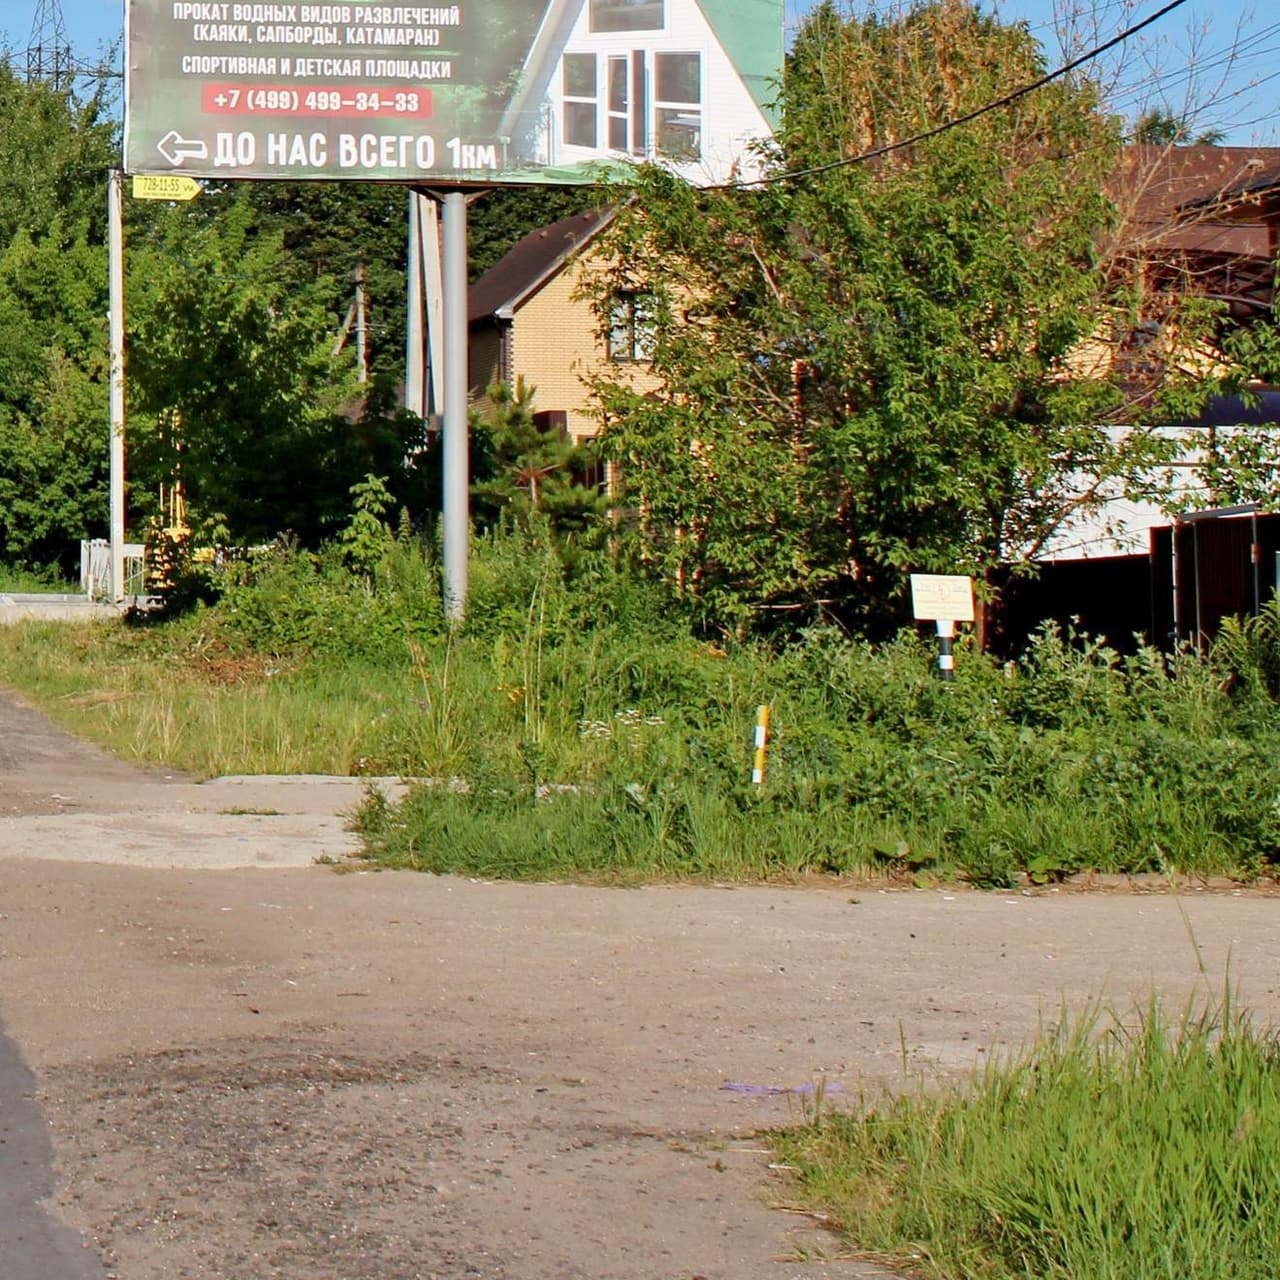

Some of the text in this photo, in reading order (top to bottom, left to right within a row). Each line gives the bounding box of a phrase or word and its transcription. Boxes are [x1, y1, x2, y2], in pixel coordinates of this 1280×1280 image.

[173, 2, 460, 26] ПРОКАТ ВОДНЫХ ВИДОВ РАЗВЛЕЧЕНИЙ
[193, 23, 440, 46] (КАЯКИ, САПБОРДЫ, КАТАМАРАН)
[181, 55, 451, 79] СПОРТИВНАЯ И ДЕТСКАЯ ПЛОЩАДКИ
[213, 89, 241, 108] +7
[246, 89, 299, 110] (499)
[213, 131, 256, 167] ДО
[267, 132, 327, 168] НАС
[339, 133, 436, 170] ВСЕГО
